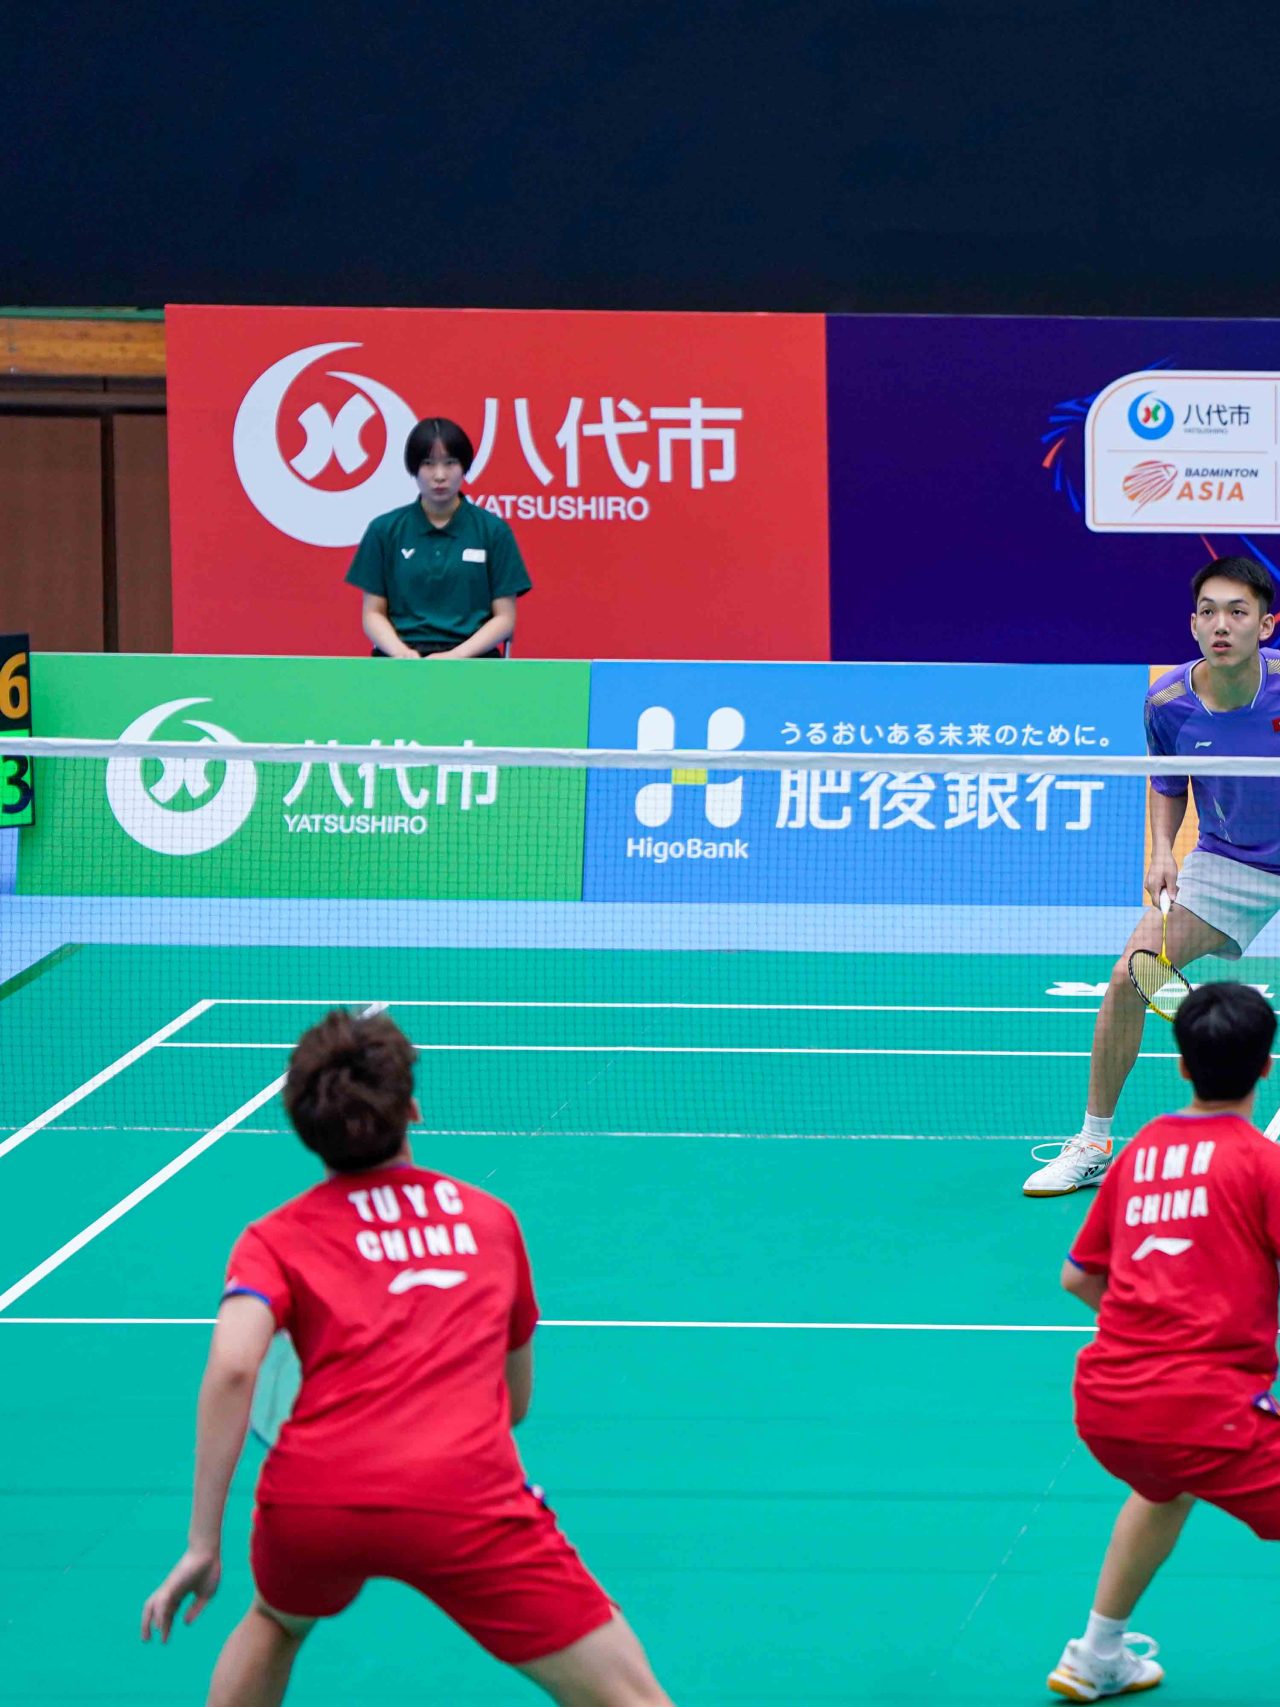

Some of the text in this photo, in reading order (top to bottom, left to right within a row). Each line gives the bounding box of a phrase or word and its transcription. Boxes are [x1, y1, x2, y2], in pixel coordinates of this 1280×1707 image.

[1183, 404, 1251, 427] 八代市
[464, 396, 743, 490] 八代市
[1184, 467, 1259, 478] BADMINTON
[1176, 480, 1245, 501] ASIA
[780, 721, 1112, 748] うるおいある未来のために。
[283, 739, 498, 810] 八代市
[775, 769, 1105, 832] 肥後銀行
[283, 814, 428, 834] YATSUSHIRO
[626, 837, 749, 863] HigoBank
[1125, 1185, 1209, 1227] CHINA
[355, 1222, 479, 1263] CHINA
